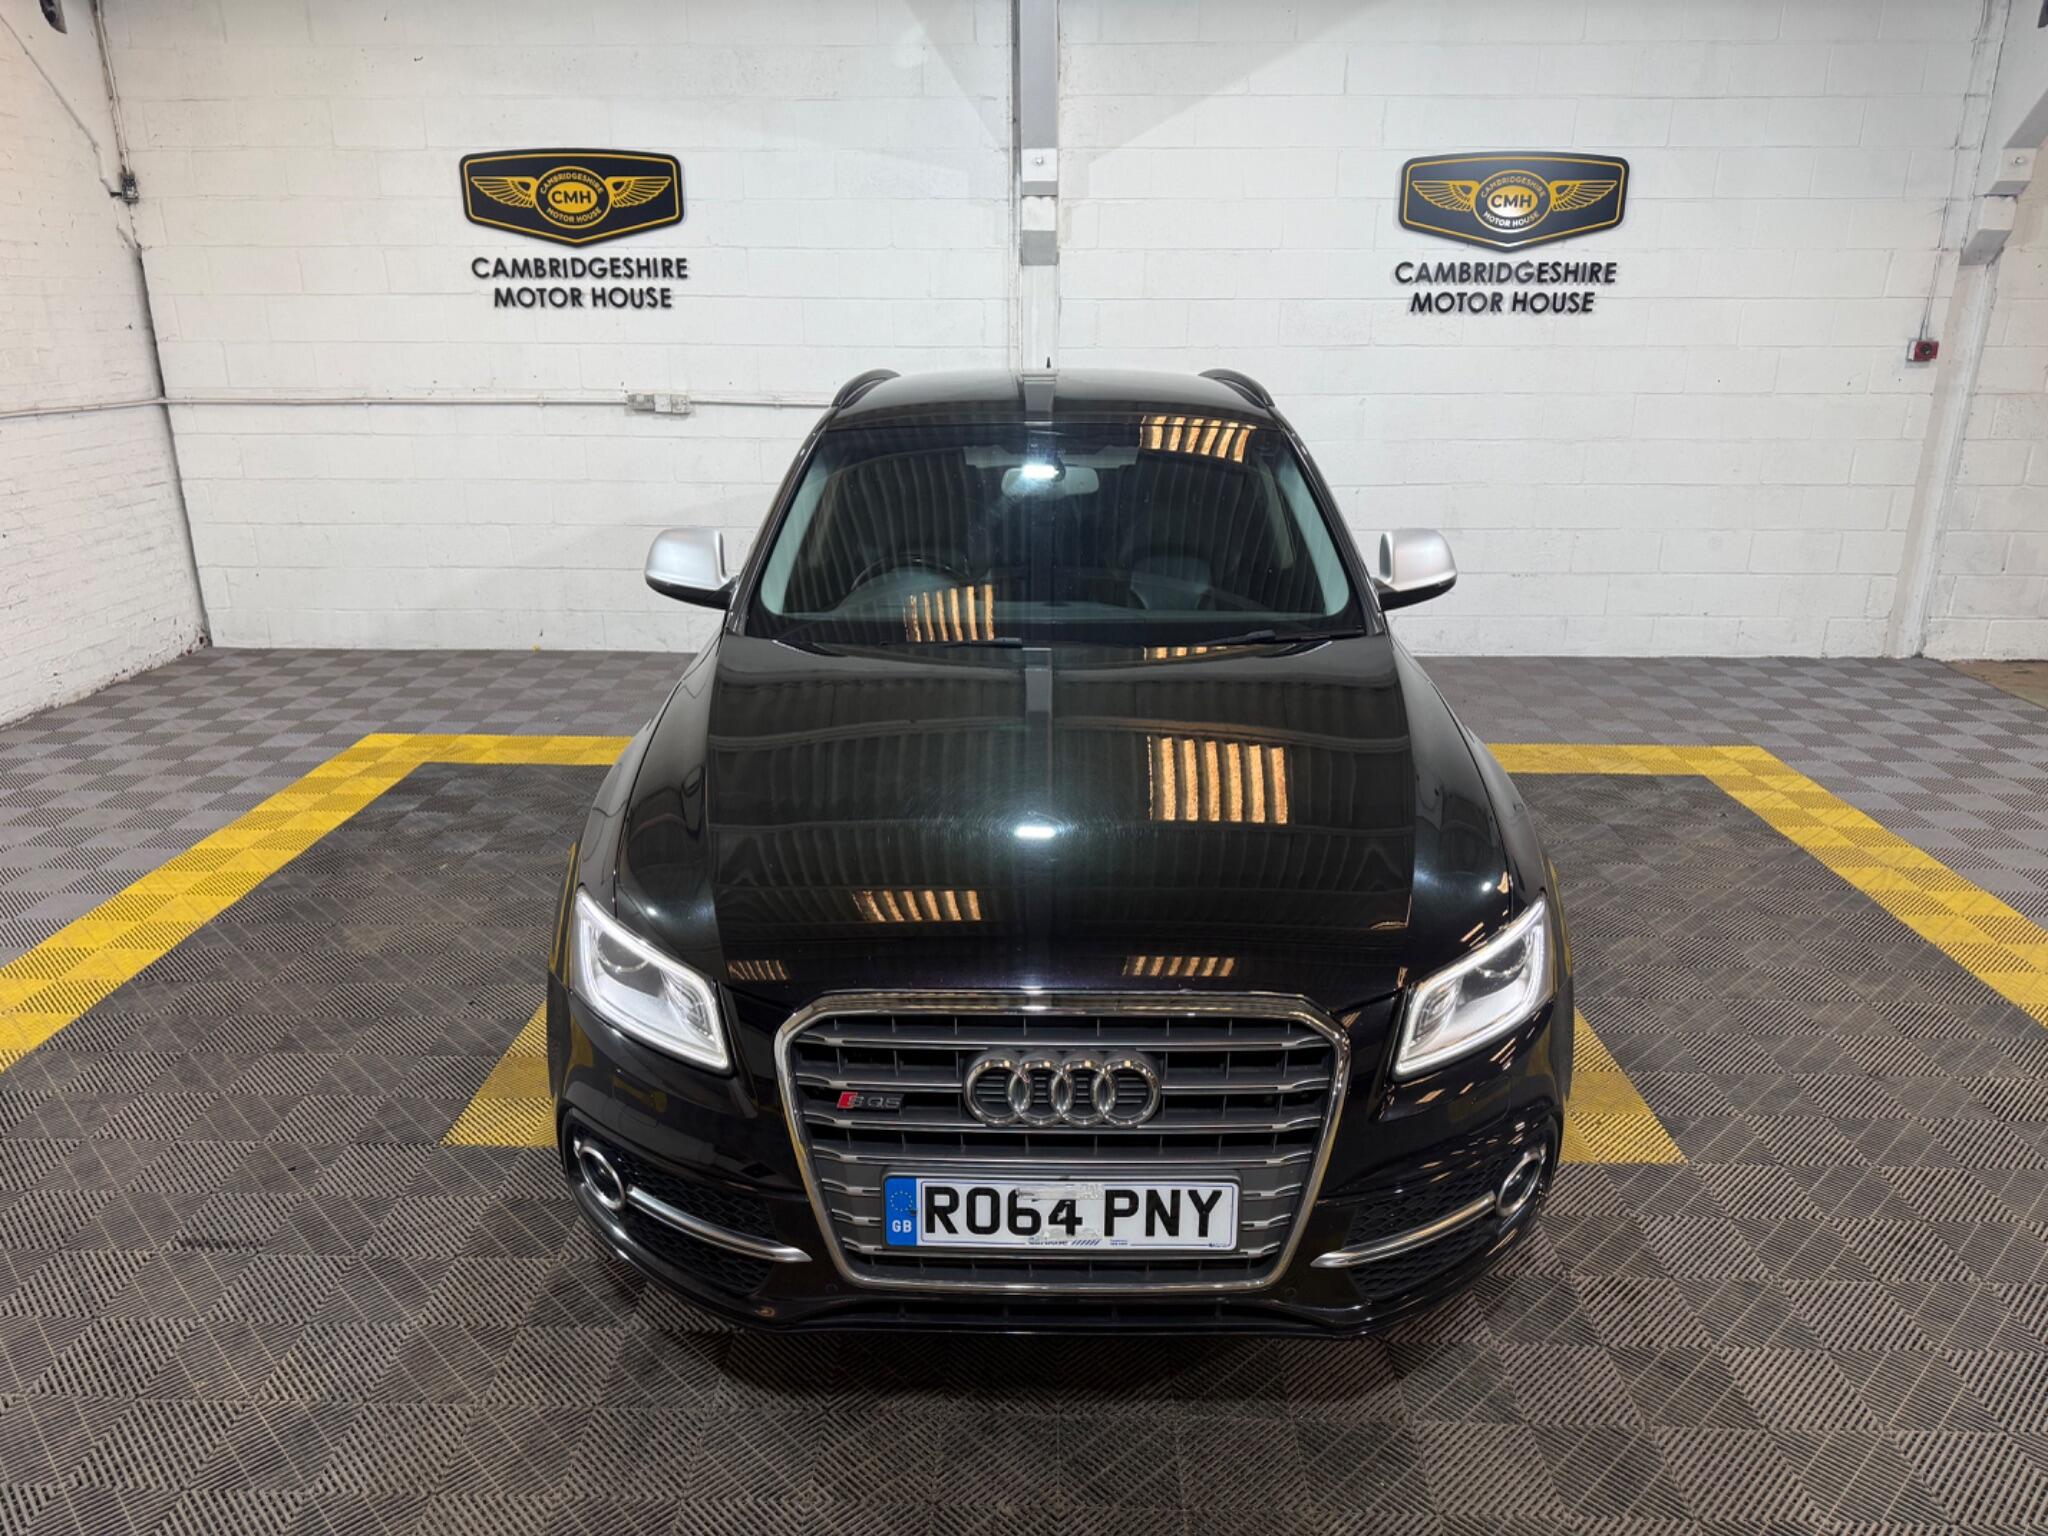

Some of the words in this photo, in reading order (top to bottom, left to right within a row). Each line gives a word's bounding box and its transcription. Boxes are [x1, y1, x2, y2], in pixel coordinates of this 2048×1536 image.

[540, 172, 605, 194] CAMBRIDGESHIRE
[1481, 176, 1546, 198] CAMBRIDGESHIRE
[551, 190, 592, 204] CMH
[1491, 194, 1532, 208] CMH
[546, 207, 574, 223] MOTOR
[576, 207, 601, 223] HOUSE
[1483, 211, 1510, 227] MOTOR
[1512, 211, 1539, 227] HOUSE
[471, 257, 688, 279] CAMBRIDGESHIRE
[1395, 261, 1617, 284] CAMBRIDGESHIRE
[494, 287, 583, 308] MOTOR
[592, 287, 672, 309] HOUSE
[1410, 292, 1503, 313] MOTOR
[1512, 292, 1595, 313] HOUSE
[924, 1186, 1082, 1237] RO64
[1104, 1189, 1223, 1238] PNY
[892, 1220, 912, 1233] GB
